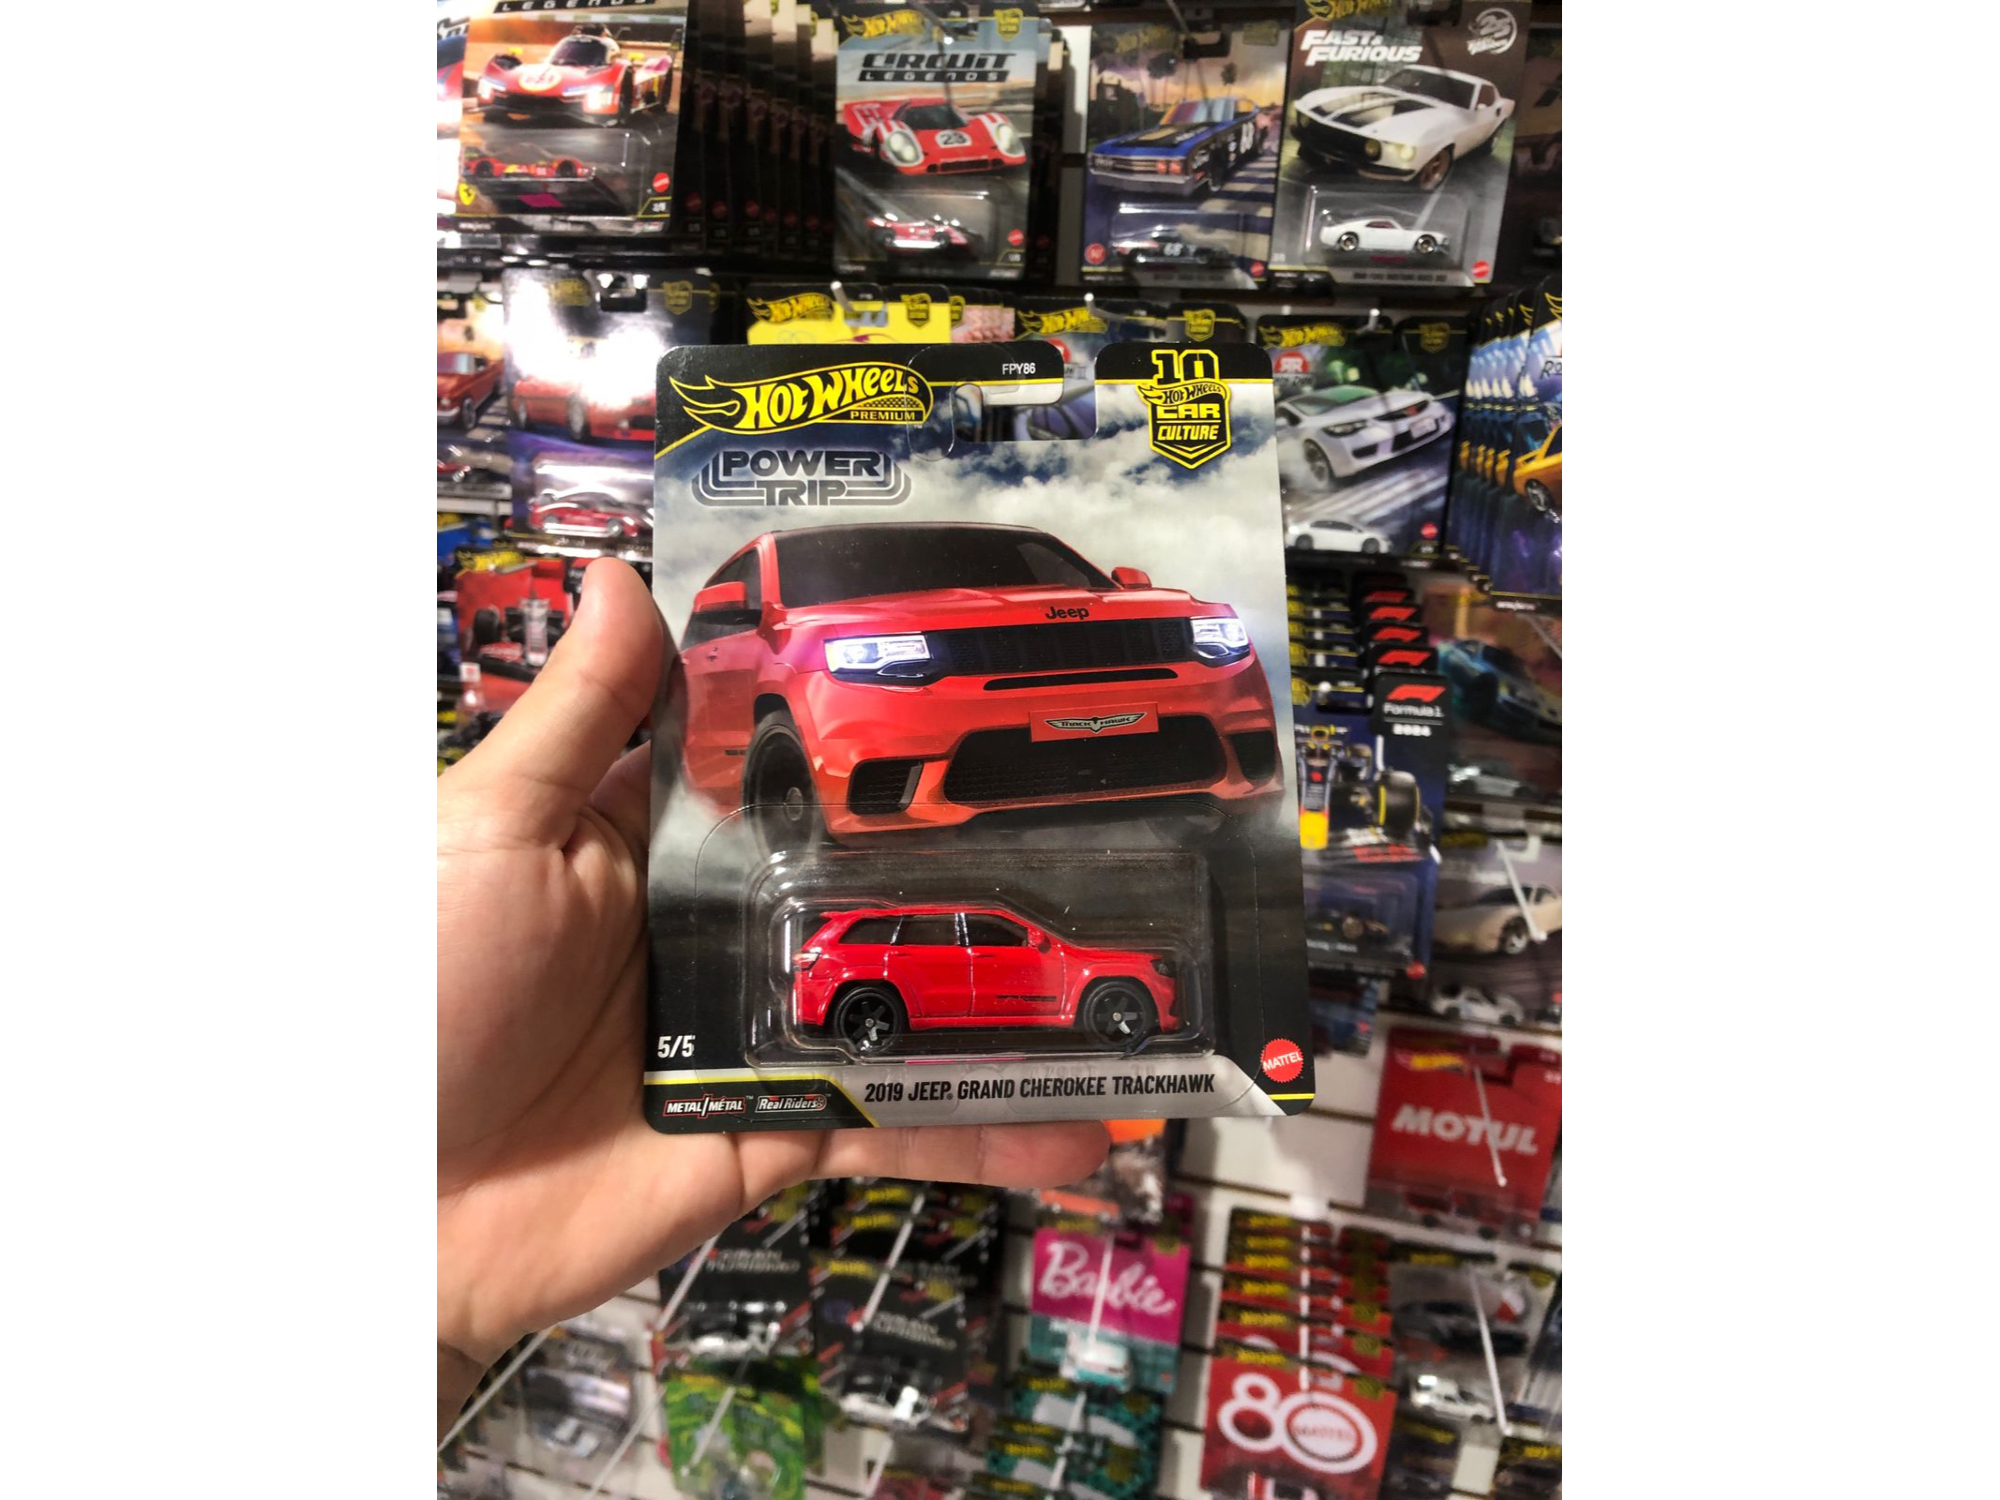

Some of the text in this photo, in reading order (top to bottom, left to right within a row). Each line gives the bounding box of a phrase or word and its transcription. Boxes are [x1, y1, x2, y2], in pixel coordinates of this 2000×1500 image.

[1301, 30, 1376, 51] FAST
[862, 52, 1016, 69] CIRCUIT
[1305, 46, 1423, 67] FURIOUS
[864, 71, 998, 81] LEGENDS
[1002, 362, 1036, 375] FPY86
[1151, 349, 1220, 384] 10
[850, 410, 916, 421] PREMIUM
[1156, 403, 1221, 419] CAR
[1157, 425, 1219, 441] CULTURE
[722, 451, 883, 477] POWER
[757, 480, 849, 506] TRIP
[1045, 606, 1090, 620] Jeep
[657, 1035, 696, 1058] 5/5
[1262, 1051, 1304, 1071] MATTEL
[864, 1082, 904, 1103] 2019
[957, 1079, 1016, 1100] GRAND
[1020, 1076, 1107, 1098] CHEROKEE
[1112, 1073, 1216, 1095] TRACKHAWK
[758, 1096, 818, 1110] Real Riders
[1391, 1102, 1539, 1156] MOTUL
[1217, 1373, 1378, 1474] 80
